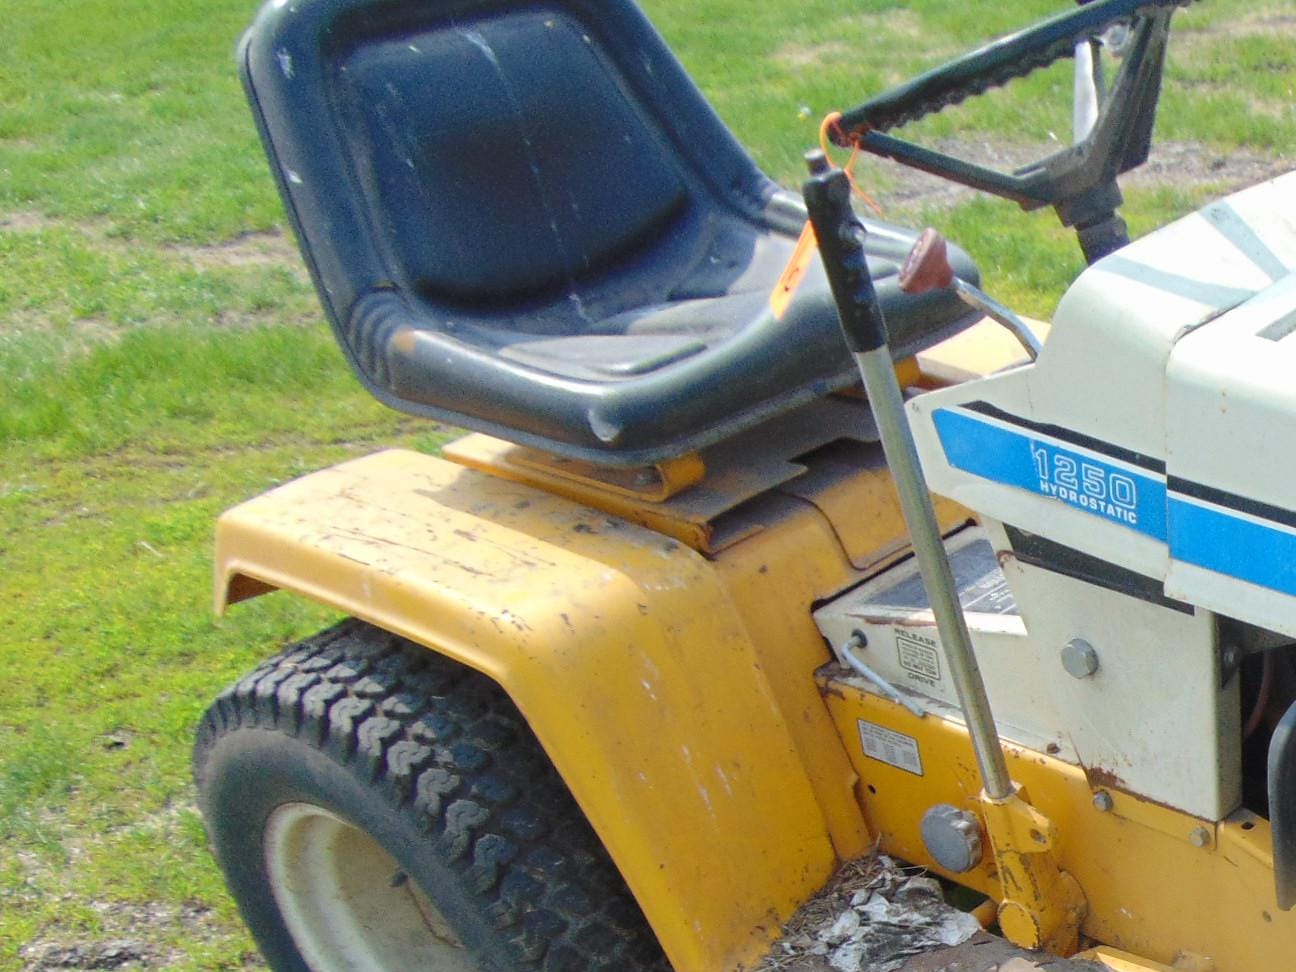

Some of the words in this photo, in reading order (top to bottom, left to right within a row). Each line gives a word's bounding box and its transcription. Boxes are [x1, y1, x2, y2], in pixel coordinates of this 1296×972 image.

[1035, 448, 1137, 509] 1250
[1040, 480, 1137, 524] HYDROSTATIC
[895, 628, 937, 648] RELEASE
[907, 673, 935, 687] DRIVE
